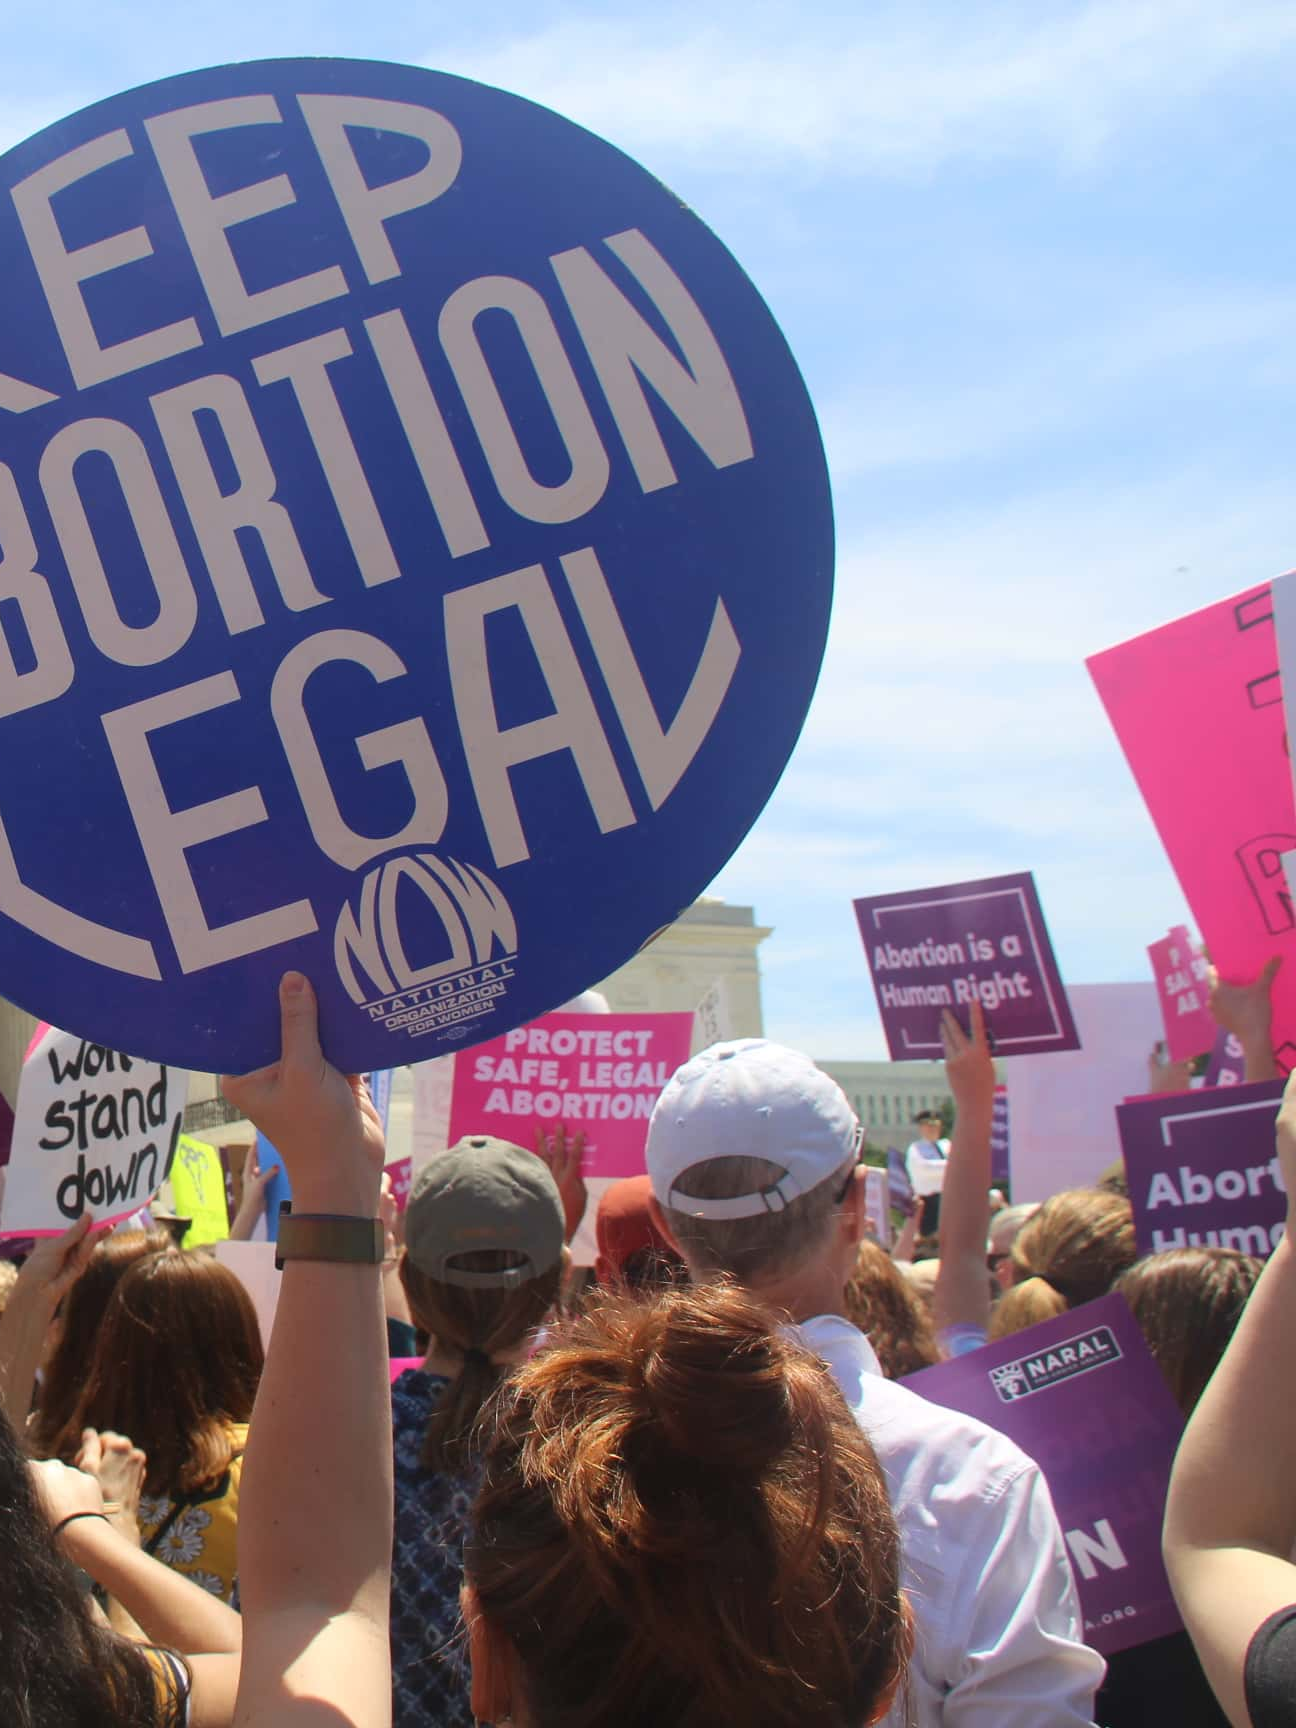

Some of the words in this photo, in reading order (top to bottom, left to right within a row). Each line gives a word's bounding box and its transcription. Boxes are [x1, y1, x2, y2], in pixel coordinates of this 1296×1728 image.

[334, 854, 518, 1005] NOW
[874, 937, 966, 970] Abortion
[966, 932, 996, 961] is
[1000, 934, 1023, 958] a
[368, 963, 515, 1018] NATIONAL
[385, 982, 505, 1028] ORGANIZATION
[879, 983, 952, 1008] Human
[953, 971, 1032, 1010] Right
[408, 1019, 436, 1035] FOR
[438, 999, 495, 1025] WOMEN
[504, 1028, 653, 1057] PROTECT
[473, 1056, 569, 1090] SAFE,
[578, 1061, 671, 1088] LEGAL
[39, 1065, 167, 1150] stand
[483, 1087, 655, 1120] ABORTION
[1146, 1157, 1288, 1210] Abort
[1026, 1336, 1109, 1378] NARAL
